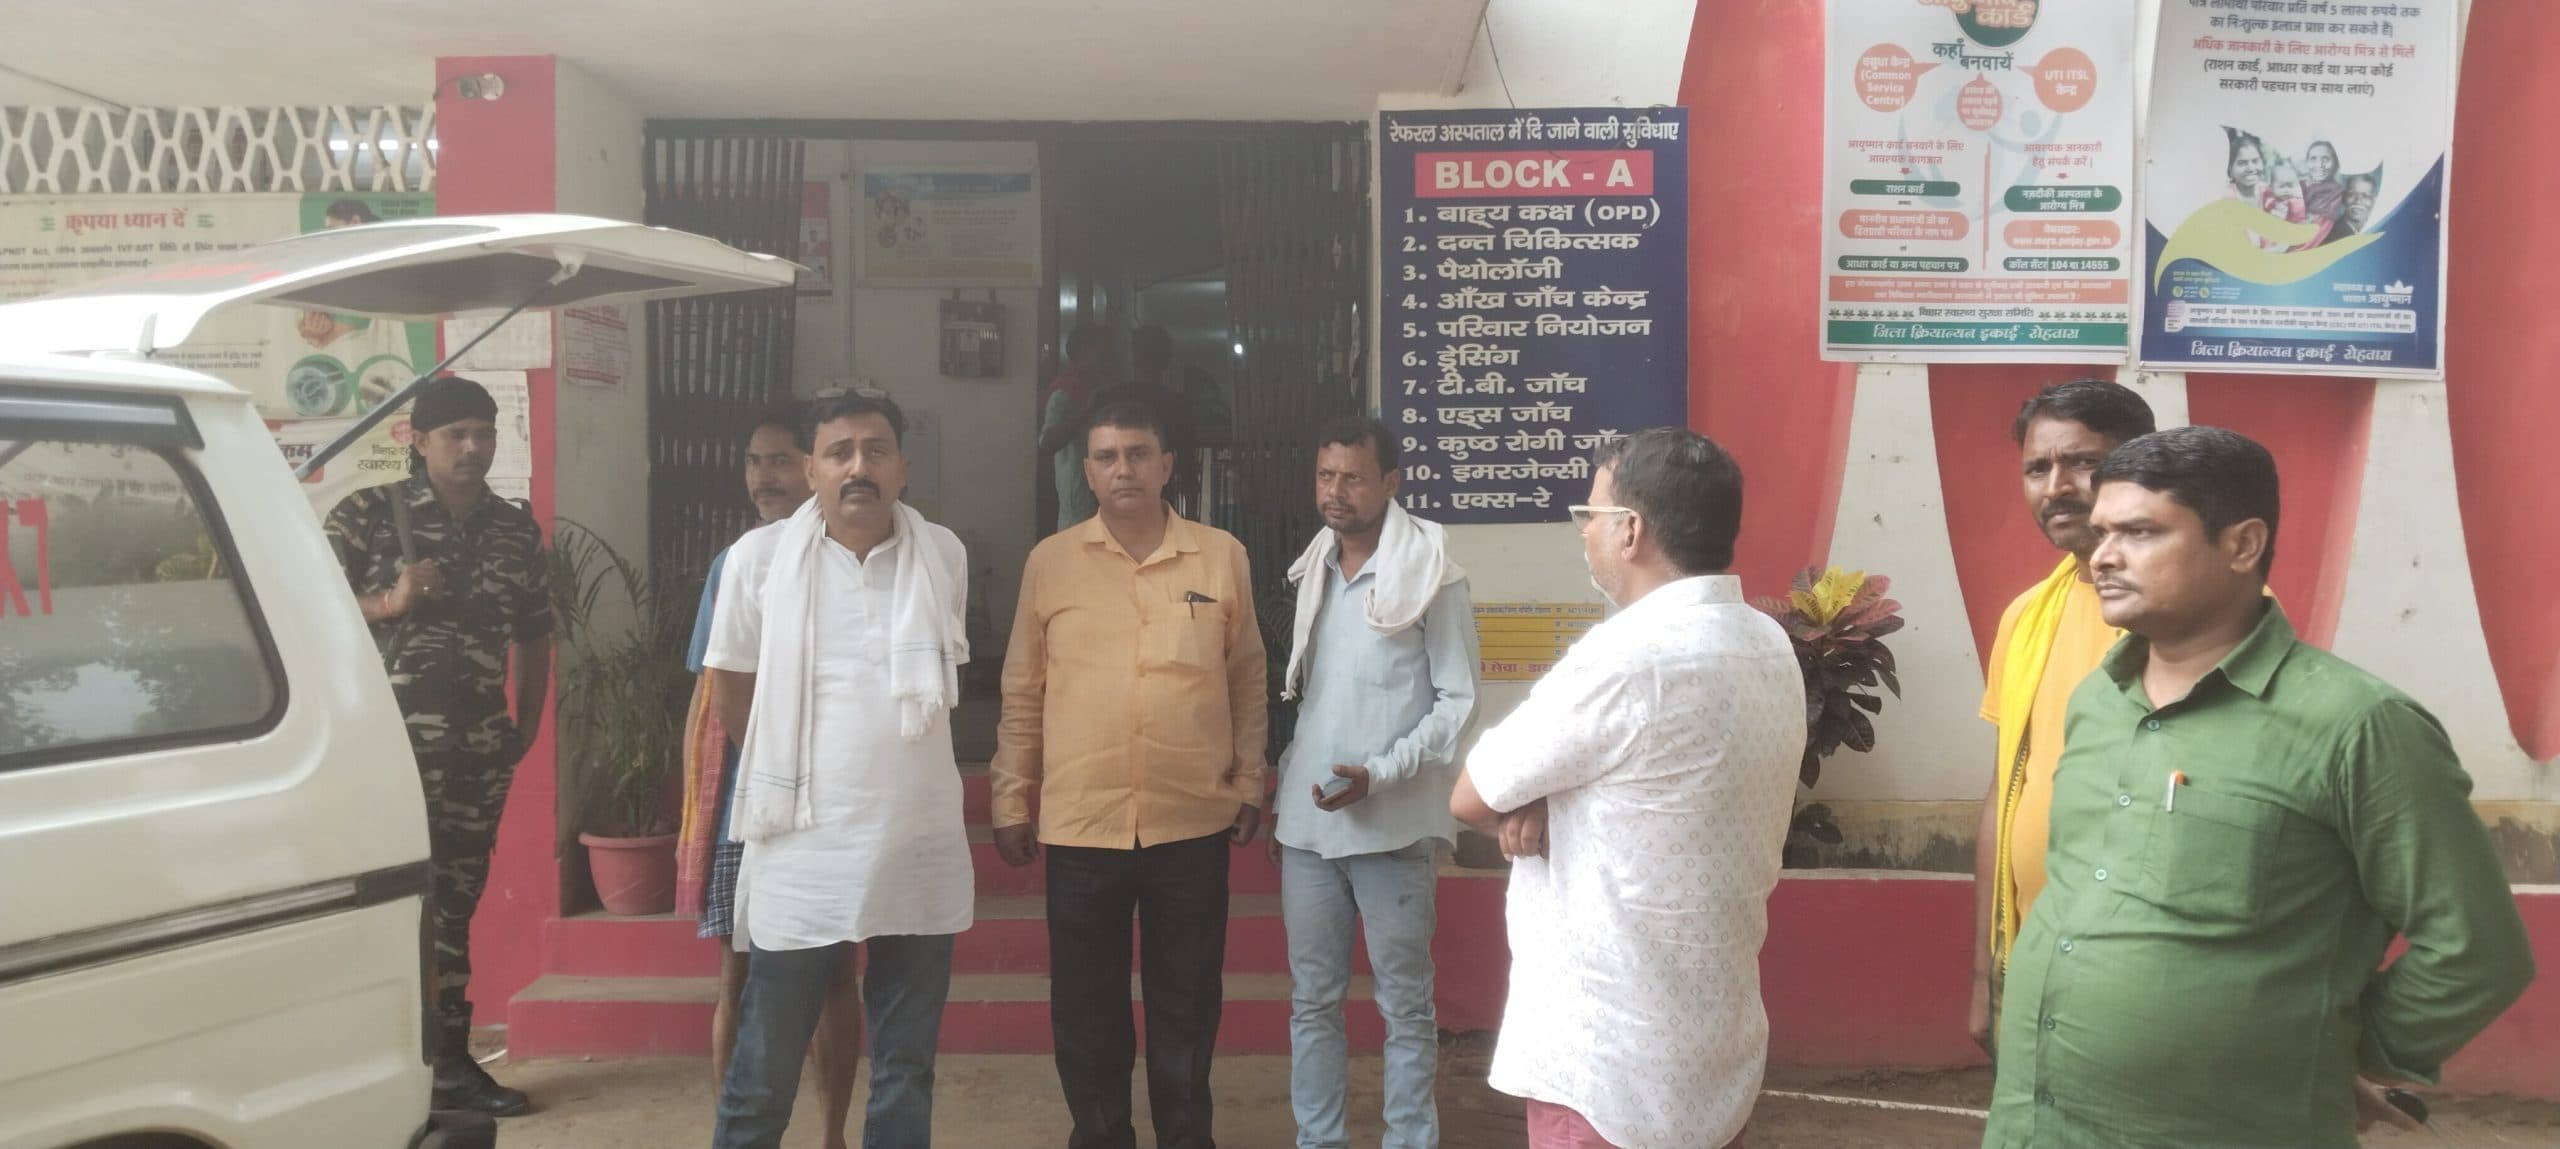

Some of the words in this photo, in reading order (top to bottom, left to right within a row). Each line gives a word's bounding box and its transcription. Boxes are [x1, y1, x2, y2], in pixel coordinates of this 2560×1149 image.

[2330, 5, 2337, 15] 5
[2341, 5, 2369, 16] लाख
[2400, 7, 2422, 17] तक
[2209, 16, 2225, 28] का
[2271, 20, 2302, 32] इलाज
[2328, 23, 2346, 33] कर
[2349, 21, 2378, 34] सकते
[2192, 35, 2225, 50] अधिक
[2227, 39, 2270, 53] जानकारी
[2273, 40, 2285, 53] के
[2379, 43, 2389, 57] से
[1960, 51, 2014, 71] बनवायें
[2204, 59, 2234, 72] (राशन
[2267, 62, 2298, 73] आधार
[2301, 61, 2324, 75] कार्ड
[2327, 65, 2341, 75] या
[2344, 65, 2368, 76] अन्य
[2370, 62, 2393, 77] कोई
[1861, 70, 1911, 80] (Common
[2219, 77, 2258, 90] सरकारी
[2261, 80, 2297, 92] पहचान
[2300, 82, 2318, 93] पत्र
[2321, 83, 2344, 94] साथ
[1866, 82, 1905, 93] Service
[1389, 120, 1435, 142] रेफरल
[1440, 121, 1505, 142] अस्पताल
[1508, 117, 1526, 140] में
[1546, 117, 1580, 140] जाने
[1584, 115, 1618, 140] वाली
[1936, 140, 1945, 150] के
[1435, 159, 1571, 189] BLOCK
[1583, 172, 1595, 181] -
[1606, 158, 1634, 188] A
[2094, 187, 2104, 198] के
[66, 212, 117, 236] कृपया
[124, 212, 168, 230] ध्यान
[172, 207, 189, 229] दें
[1404, 207, 1427, 224] 1.
[1519, 204, 1575, 222] कक्ष
[1584, 198, 1661, 227] (OPD)
[1402, 236, 1427, 252] 2.
[1437, 234, 1496, 252] दन्त
[1504, 226, 1642, 252] चिकित्सक
[1402, 265, 1427, 281] 3.
[1437, 256, 1563, 281] पैथोलॉजी
[2052, 261, 2067, 269] 104
[2081, 261, 2109, 269] 14555
[1401, 293, 1427, 310] 4.
[1437, 285, 1507, 310] आँख
[1582, 285, 1649, 311] केन्द्र
[1402, 322, 1427, 338] 5.
[1437, 315, 1529, 338] परिवार
[1535, 314, 1652, 337] नियोजन
[1873, 323, 1907, 339] जिला
[1980, 324, 2020, 341] इकाई
[2028, 324, 2080, 340] रोहतास
[1401, 351, 1427, 367] 6.
[1437, 343, 1520, 373] ड्रेसिंग
[2191, 340, 2224, 356] जिला
[2296, 344, 2336, 362] इकाई
[2343, 345, 2392, 362] रोहतास
[1402, 379, 1427, 395] 7.
[1437, 372, 1515, 395] टी.बी.
[1401, 408, 1427, 424] 8.
[1437, 406, 1503, 430] एड्स
[1401, 436, 1427, 452] 9.
[1437, 434, 1500, 460] कुष्ठ
[1505, 428, 1565, 452] रोगी
[1572, 429, 1629, 450] जॉ
[1403, 465, 1441, 481] 10.
[1451, 457, 1589, 482] इमरजेन्सी
[1403, 493, 1441, 510] 11.
